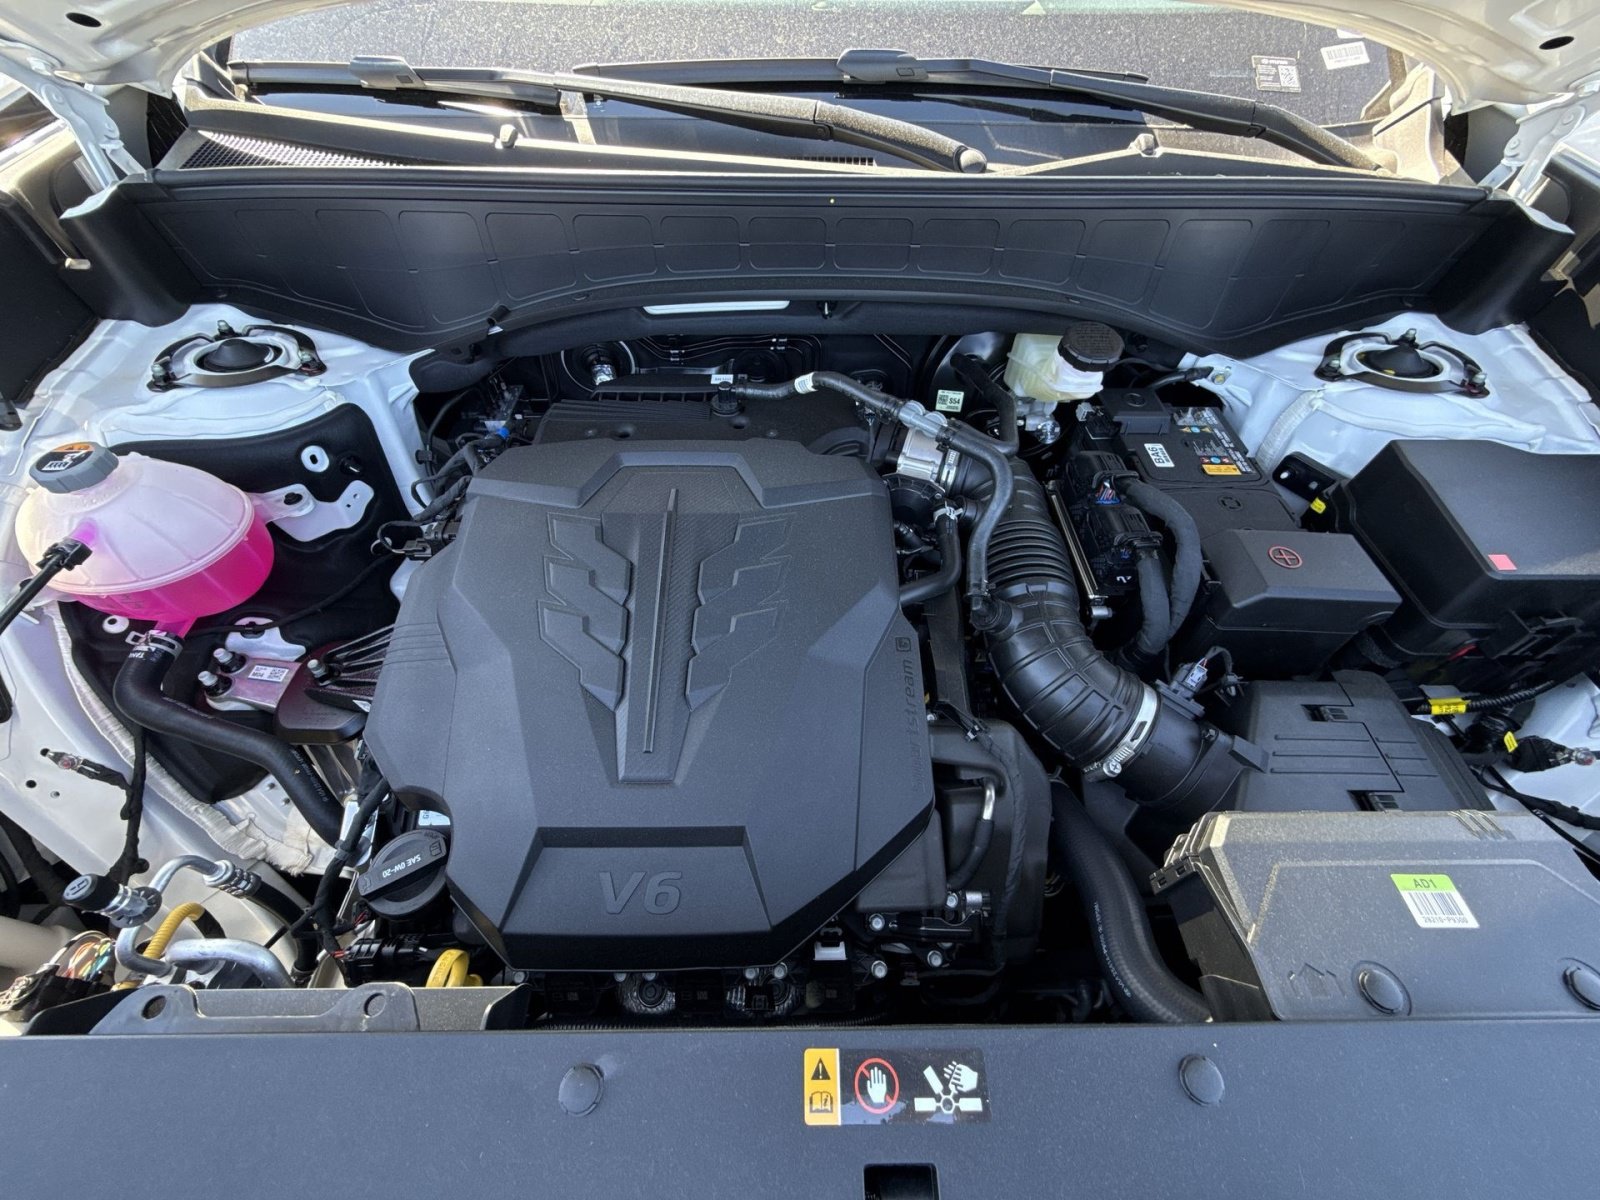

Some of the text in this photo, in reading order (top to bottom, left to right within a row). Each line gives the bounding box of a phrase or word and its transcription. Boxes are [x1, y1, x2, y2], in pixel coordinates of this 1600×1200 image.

[948, 397, 960, 405] S54
[1148, 446, 1165, 464] BA6
[382, 854, 422, 878] SAE 0W-20
[599, 870, 683, 915] V6
[1413, 878, 1438, 889] AD1
